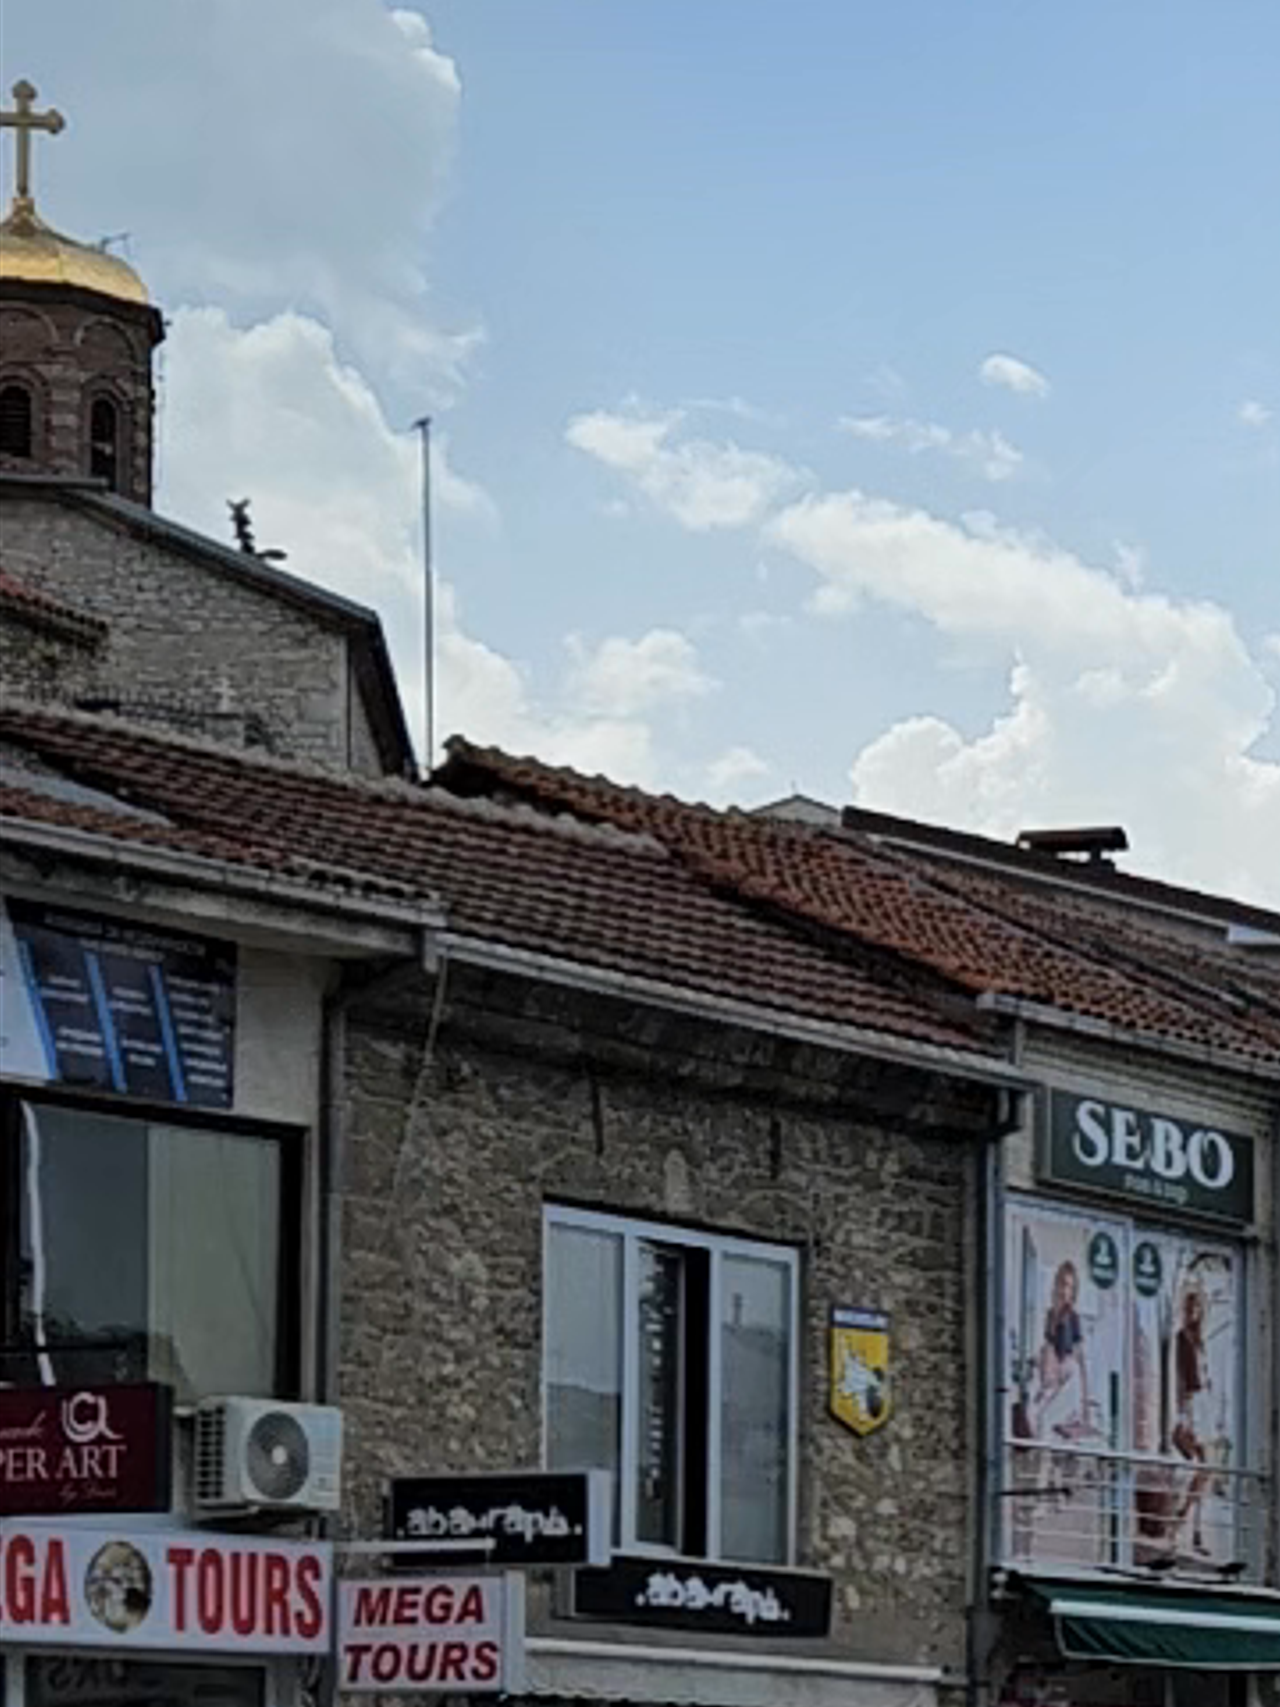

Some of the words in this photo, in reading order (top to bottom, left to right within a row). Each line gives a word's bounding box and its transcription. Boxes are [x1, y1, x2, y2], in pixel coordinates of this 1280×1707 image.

[1073, 1100, 1234, 1188] SEBO
[55, 1445, 128, 1479] ART
[0, 1534, 70, 1625] GA
[167, 1547, 323, 1639] TOURS
[354, 1584, 485, 1627] MEGA
[344, 1641, 499, 1684] TOURS
